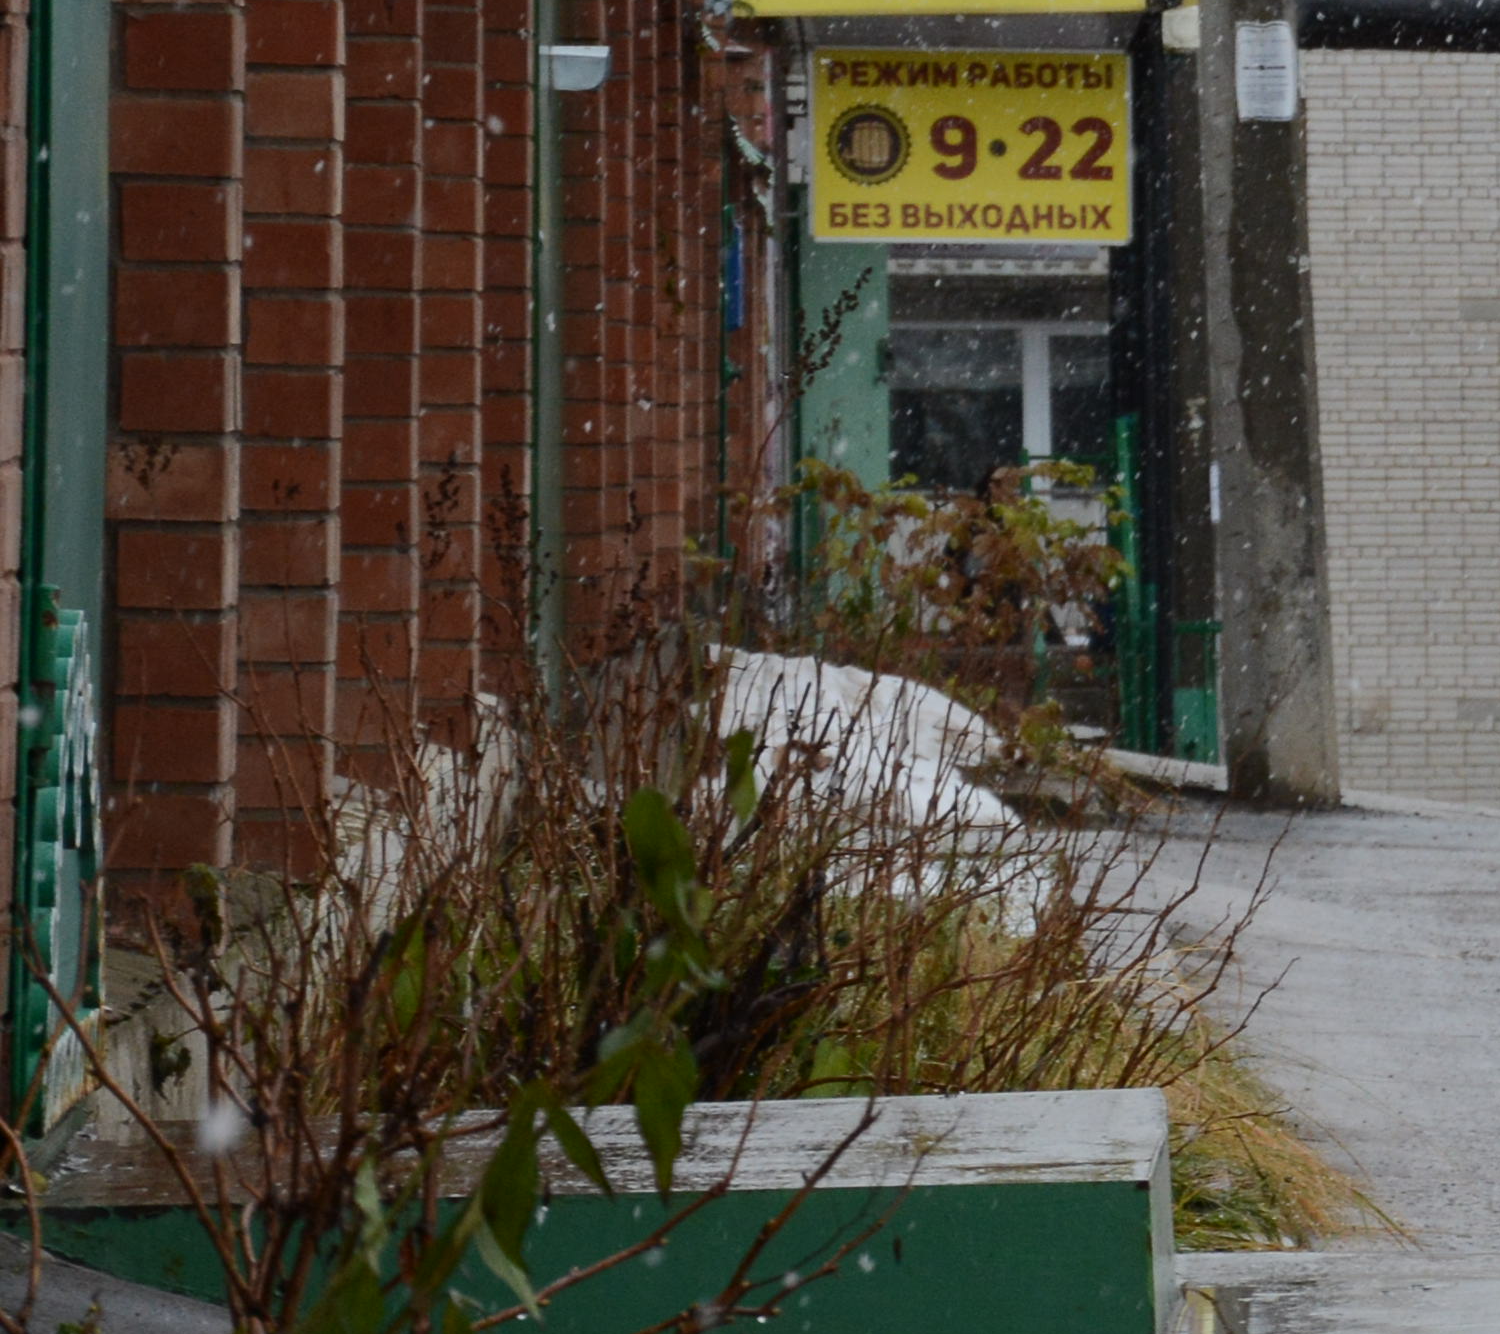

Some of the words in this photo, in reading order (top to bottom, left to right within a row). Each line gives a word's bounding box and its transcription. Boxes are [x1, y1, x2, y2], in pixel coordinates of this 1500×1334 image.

[827, 61, 958, 88] РЕЖИМ
[967, 62, 1114, 89] РАБОТЫ
[828, 203, 891, 228] БЕЗ
[901, 203, 1112, 234] ВЫХОДНЫХ
